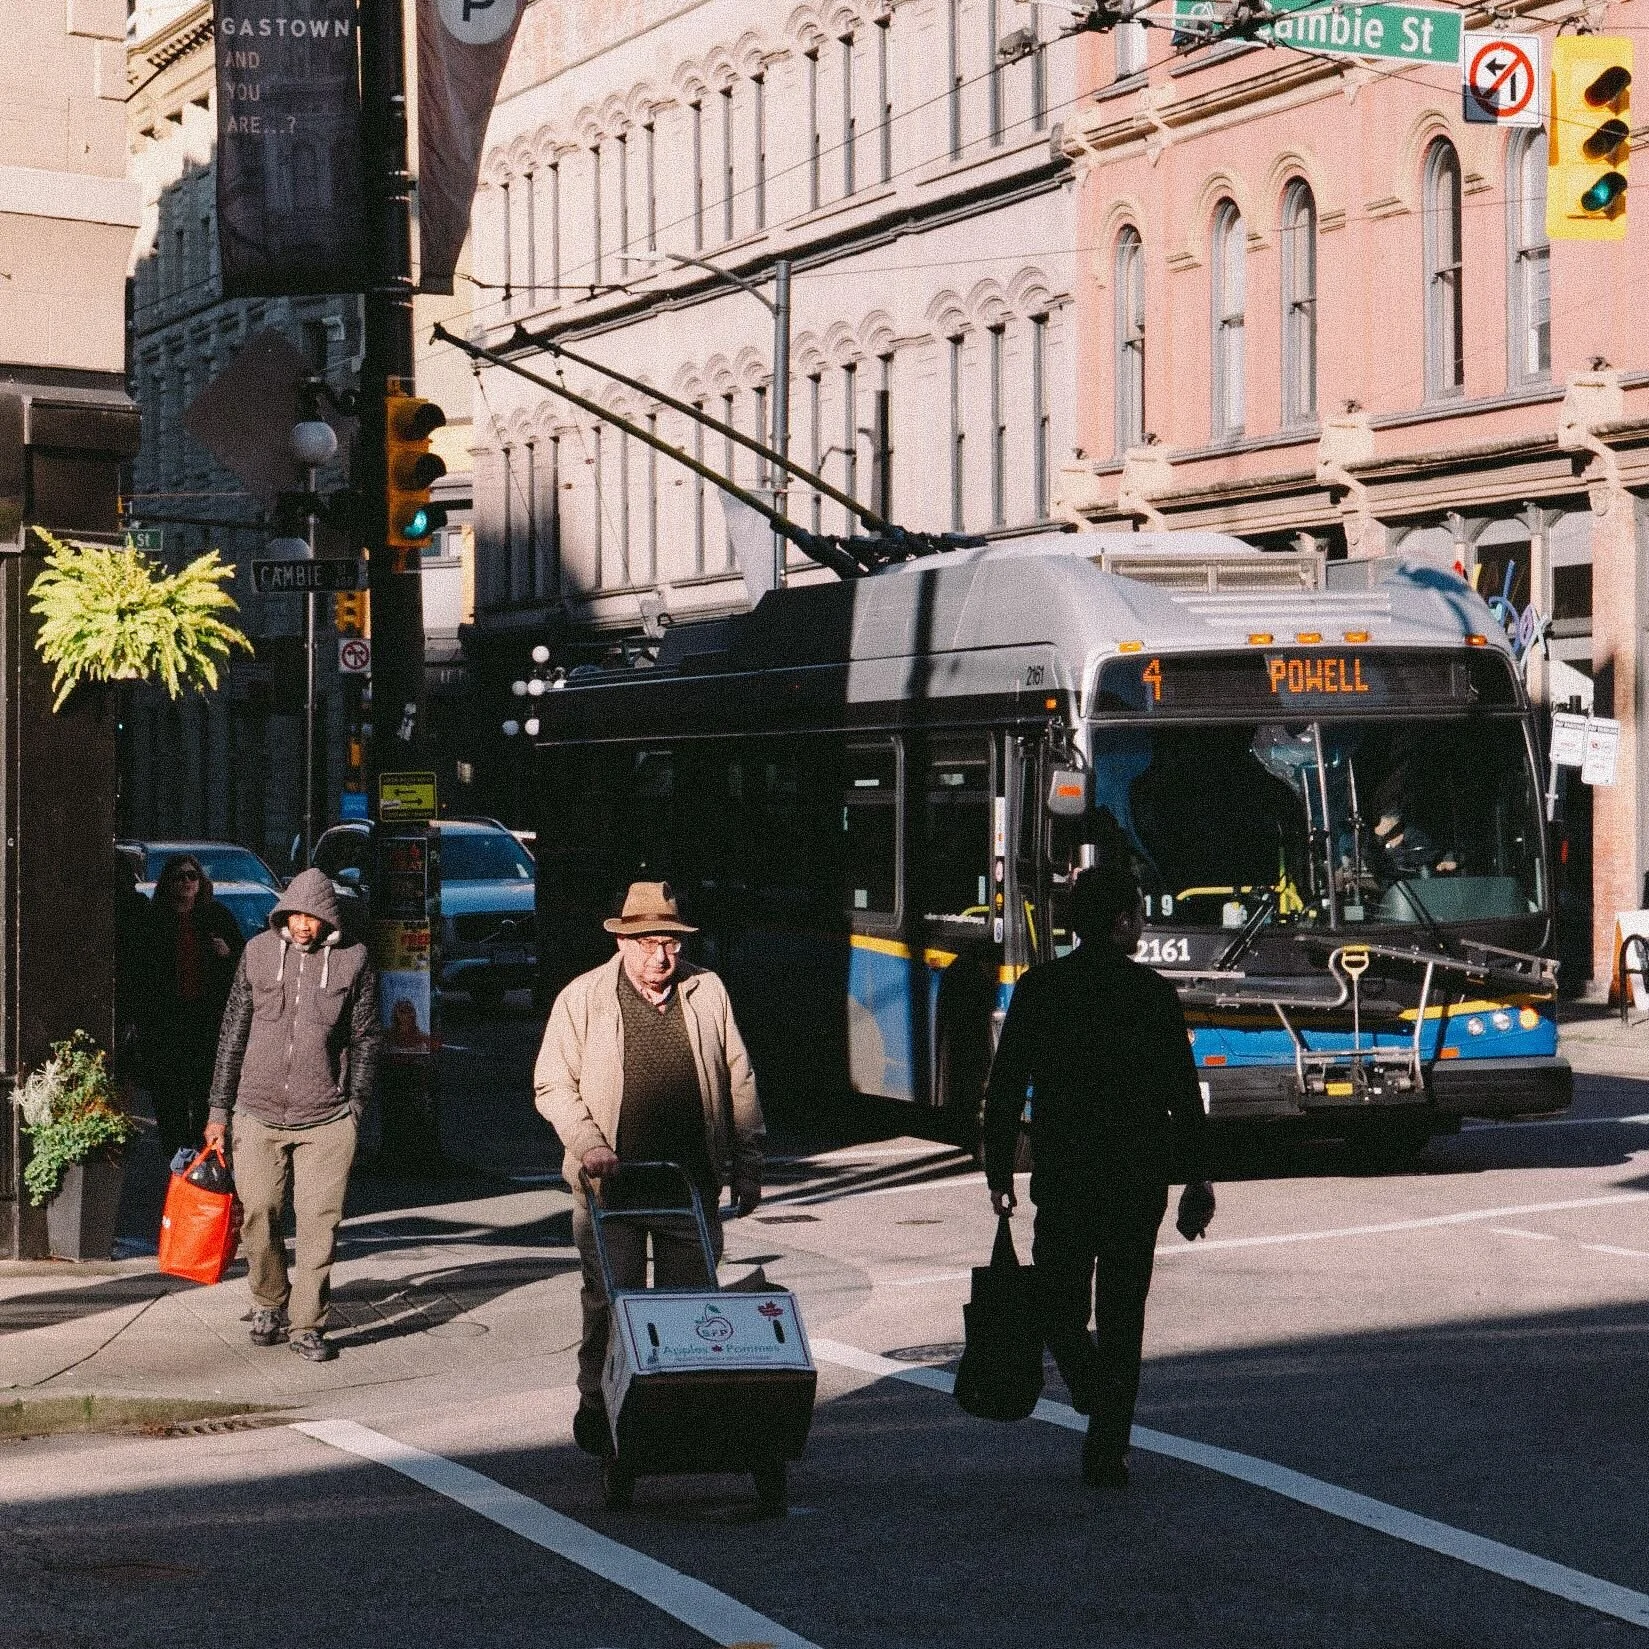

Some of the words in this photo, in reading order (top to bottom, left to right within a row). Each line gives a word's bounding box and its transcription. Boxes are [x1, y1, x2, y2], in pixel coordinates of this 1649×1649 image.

[221, 17, 350, 38] GASTOWN
[1400, 16, 1434, 55] St
[225, 51, 260, 69] AND
[227, 82, 260, 101] YOU
[260, 564, 323, 587] CAMBIE
[1141, 659, 1163, 701] 4
[1270, 659, 1370, 694] POWELL
[1133, 938, 1191, 962] 2161
[662, 1343, 709, 1358] Apples
